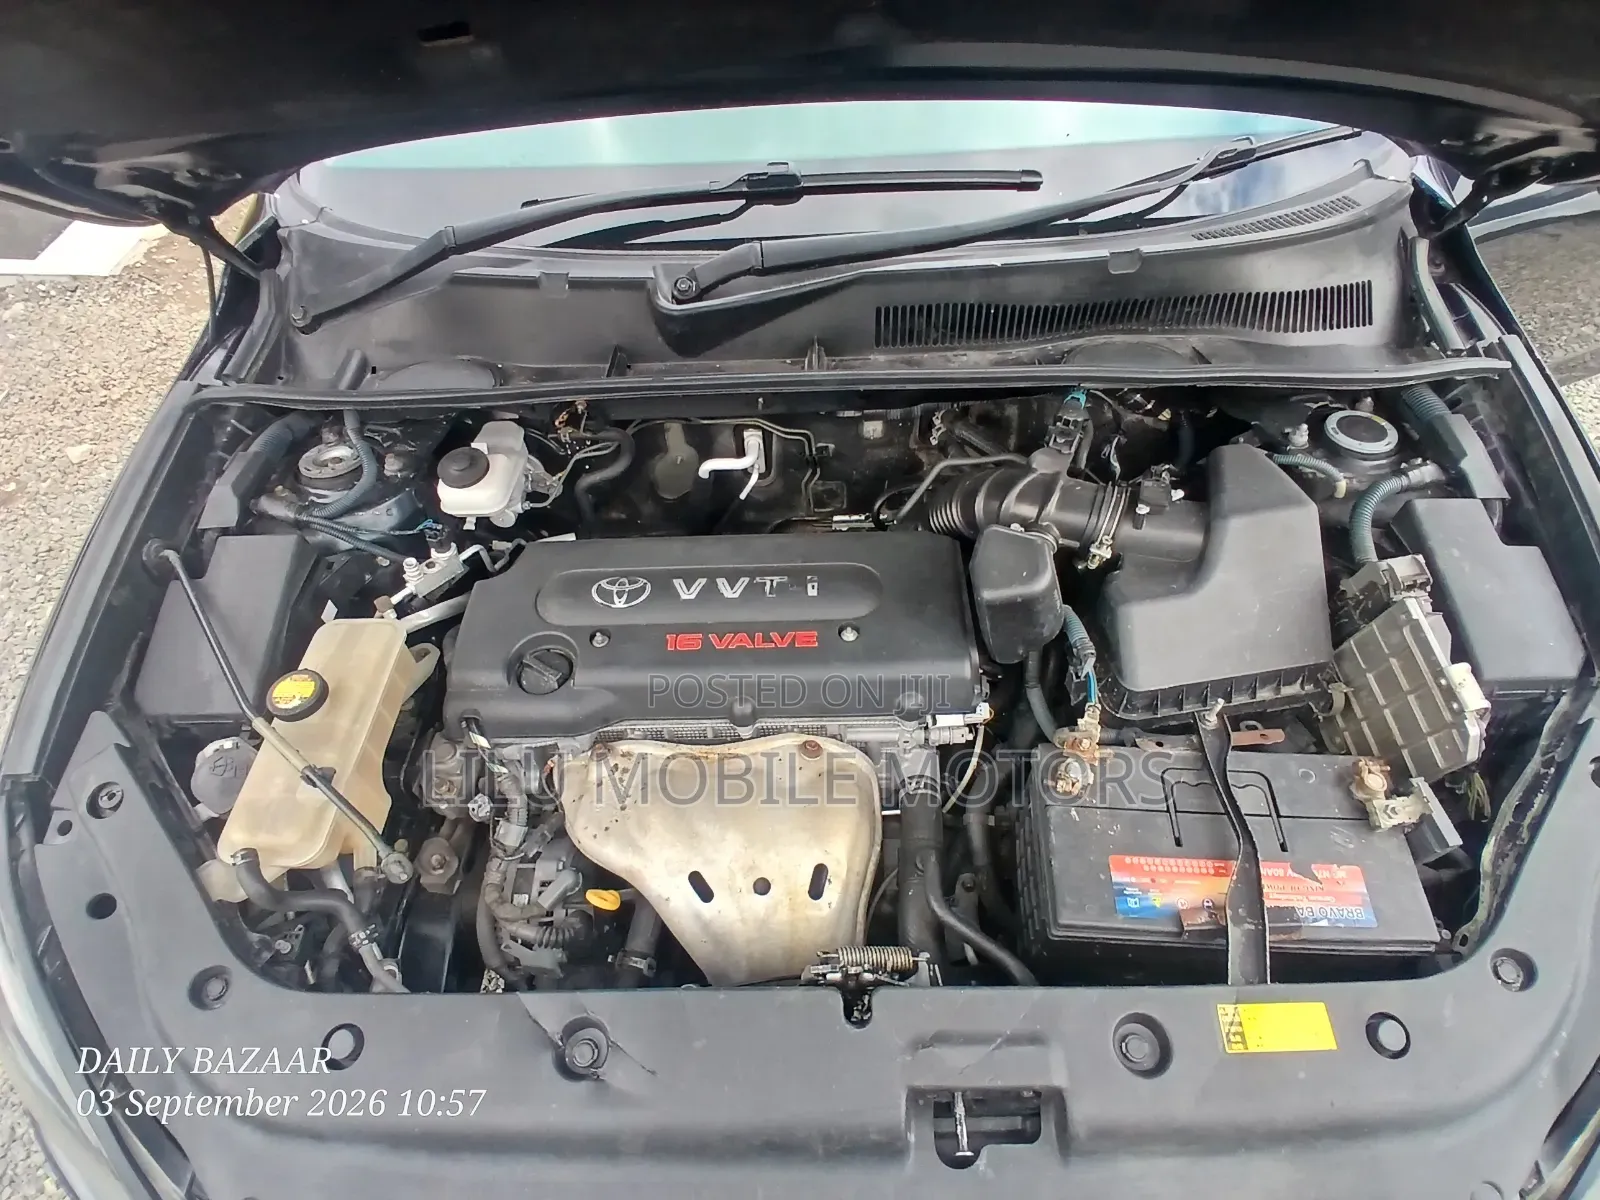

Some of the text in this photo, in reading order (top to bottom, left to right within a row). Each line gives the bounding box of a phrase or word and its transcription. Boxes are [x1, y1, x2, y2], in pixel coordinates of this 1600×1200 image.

[666, 631, 818, 651] 16 VALVE
[1264, 883, 1286, 891] POW
[1318, 906, 1365, 920] BRAVO
